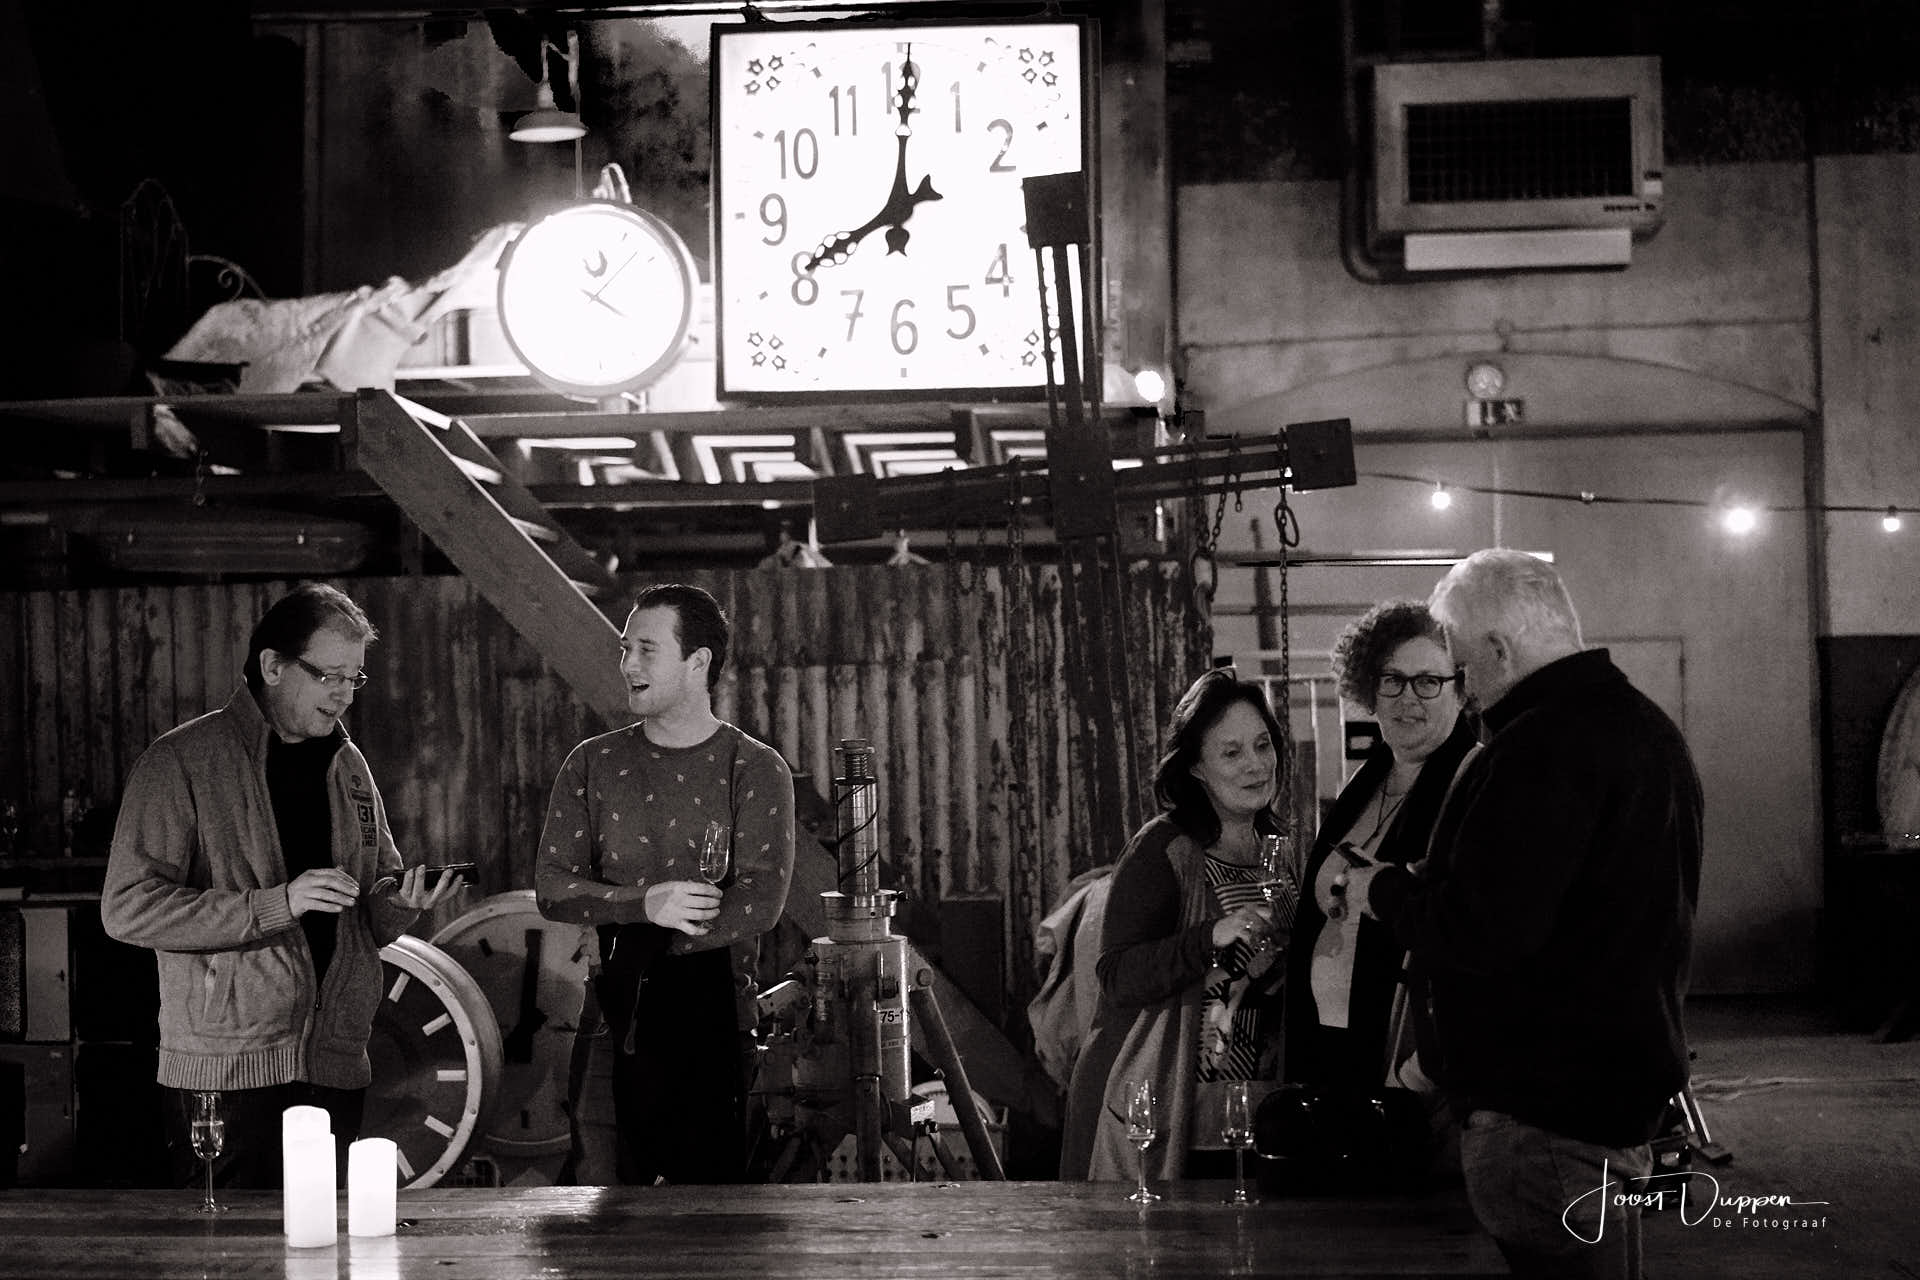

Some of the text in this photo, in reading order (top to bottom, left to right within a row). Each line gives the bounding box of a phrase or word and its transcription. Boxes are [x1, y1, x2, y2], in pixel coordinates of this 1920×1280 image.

[829, 85, 857, 136] 11
[950, 81, 961, 133] 1
[774, 128, 818, 180] 10
[987, 119, 1016, 173] 2
[759, 193, 788, 246] 9
[791, 251, 819, 306] 8
[985, 243, 1014, 298] 4
[840, 289, 864, 342] 7
[890, 299, 918, 355] 6
[946, 284, 976, 340] 5
